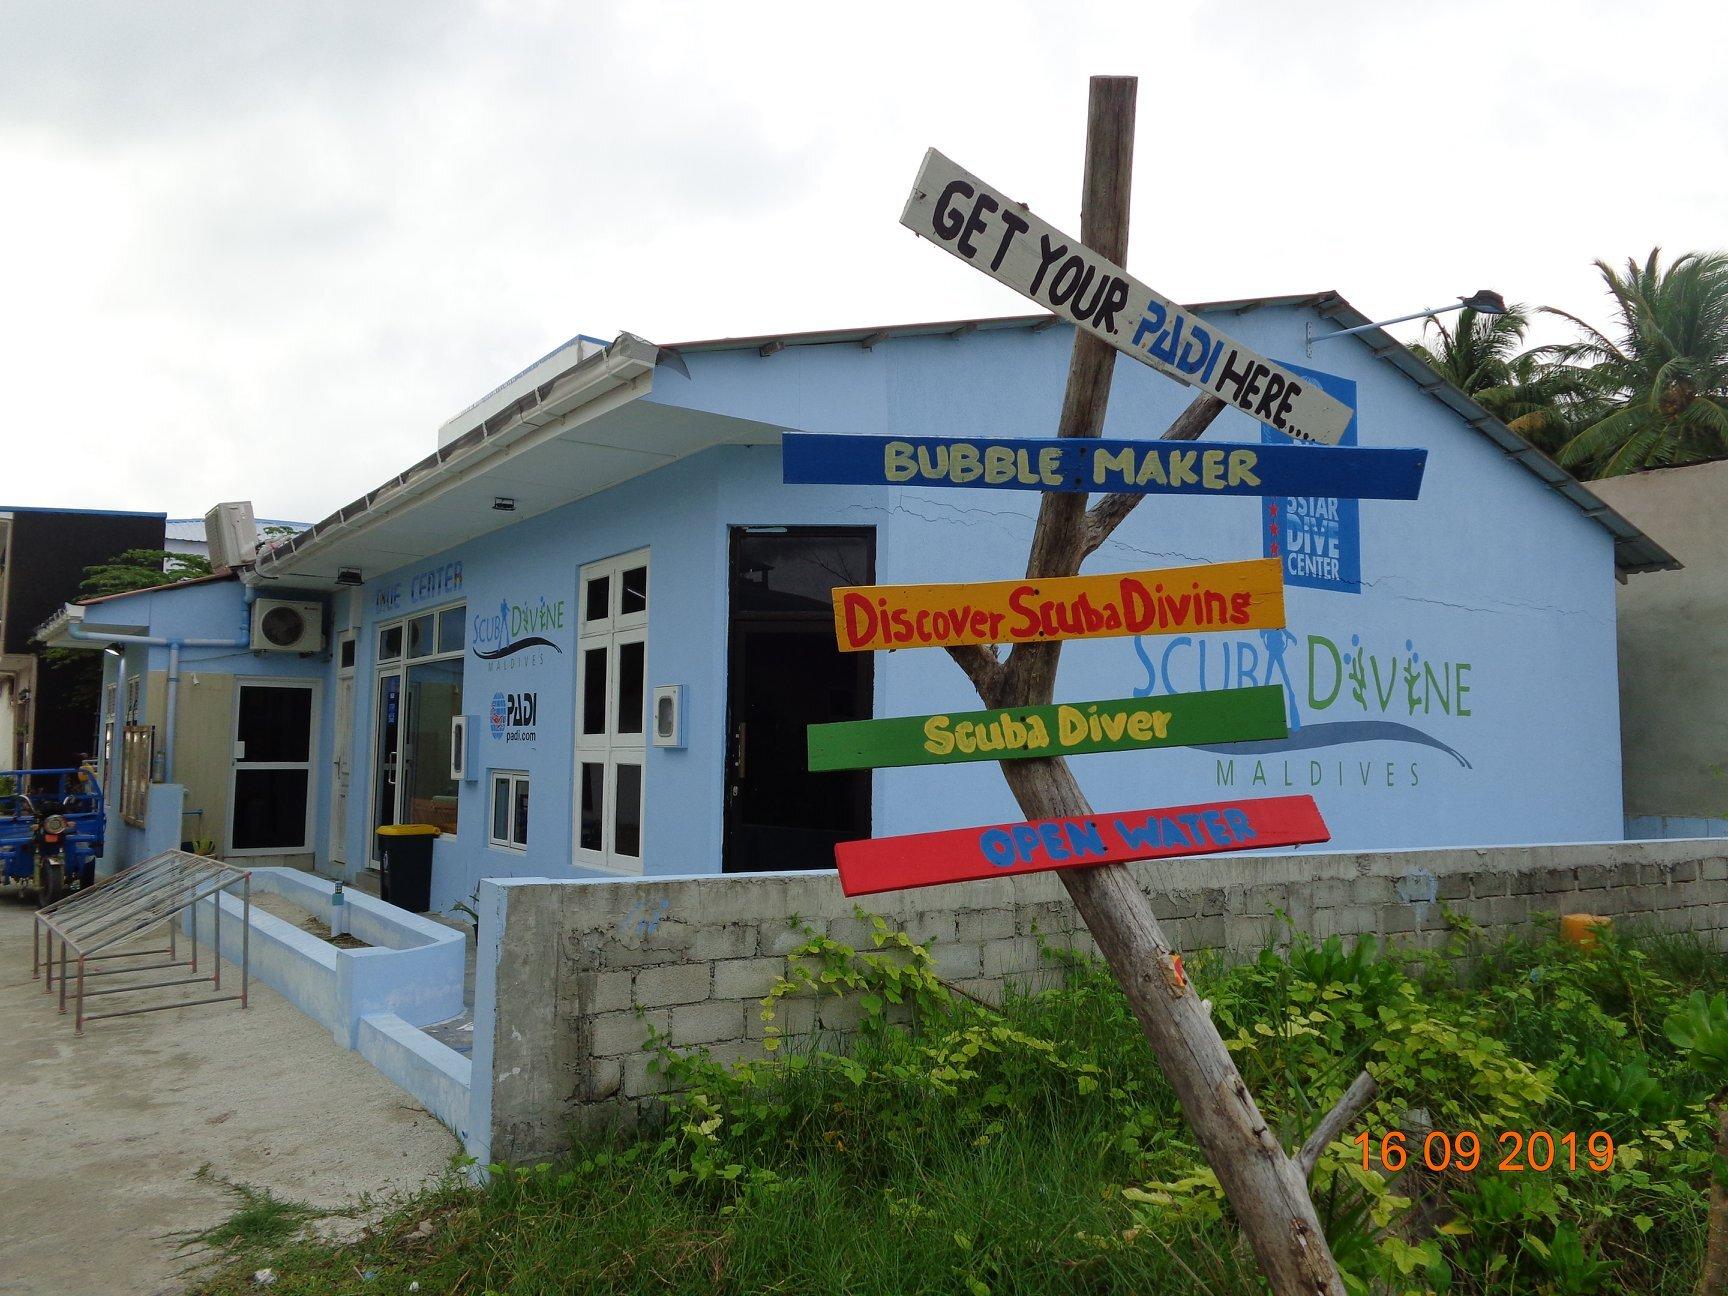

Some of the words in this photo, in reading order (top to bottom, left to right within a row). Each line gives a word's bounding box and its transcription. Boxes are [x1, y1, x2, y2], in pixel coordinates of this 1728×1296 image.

[932, 180, 1030, 272] GET
[1131, 300, 1225, 385] PADI
[884, 442, 1063, 486] BUBBLE
[1093, 447, 1262, 490] MAKER
[1286, 513, 1341, 559] DIVE
[411, 560, 464, 604] CENTER
[1287, 552, 1341, 581] CENTER
[473, 598, 510, 650] SCUBA
[843, 592, 1006, 647] Discover
[488, 653, 544, 672] MALDIVES
[506, 692, 537, 727] PADI
[923, 713, 1051, 755] Scuba
[1058, 705, 1172, 747] Diver
[506, 730, 537, 743] padi.com
[1216, 760, 1420, 788] MALDIVES
[979, 822, 1109, 868] OPEN
[1115, 808, 1257, 851] WATER
